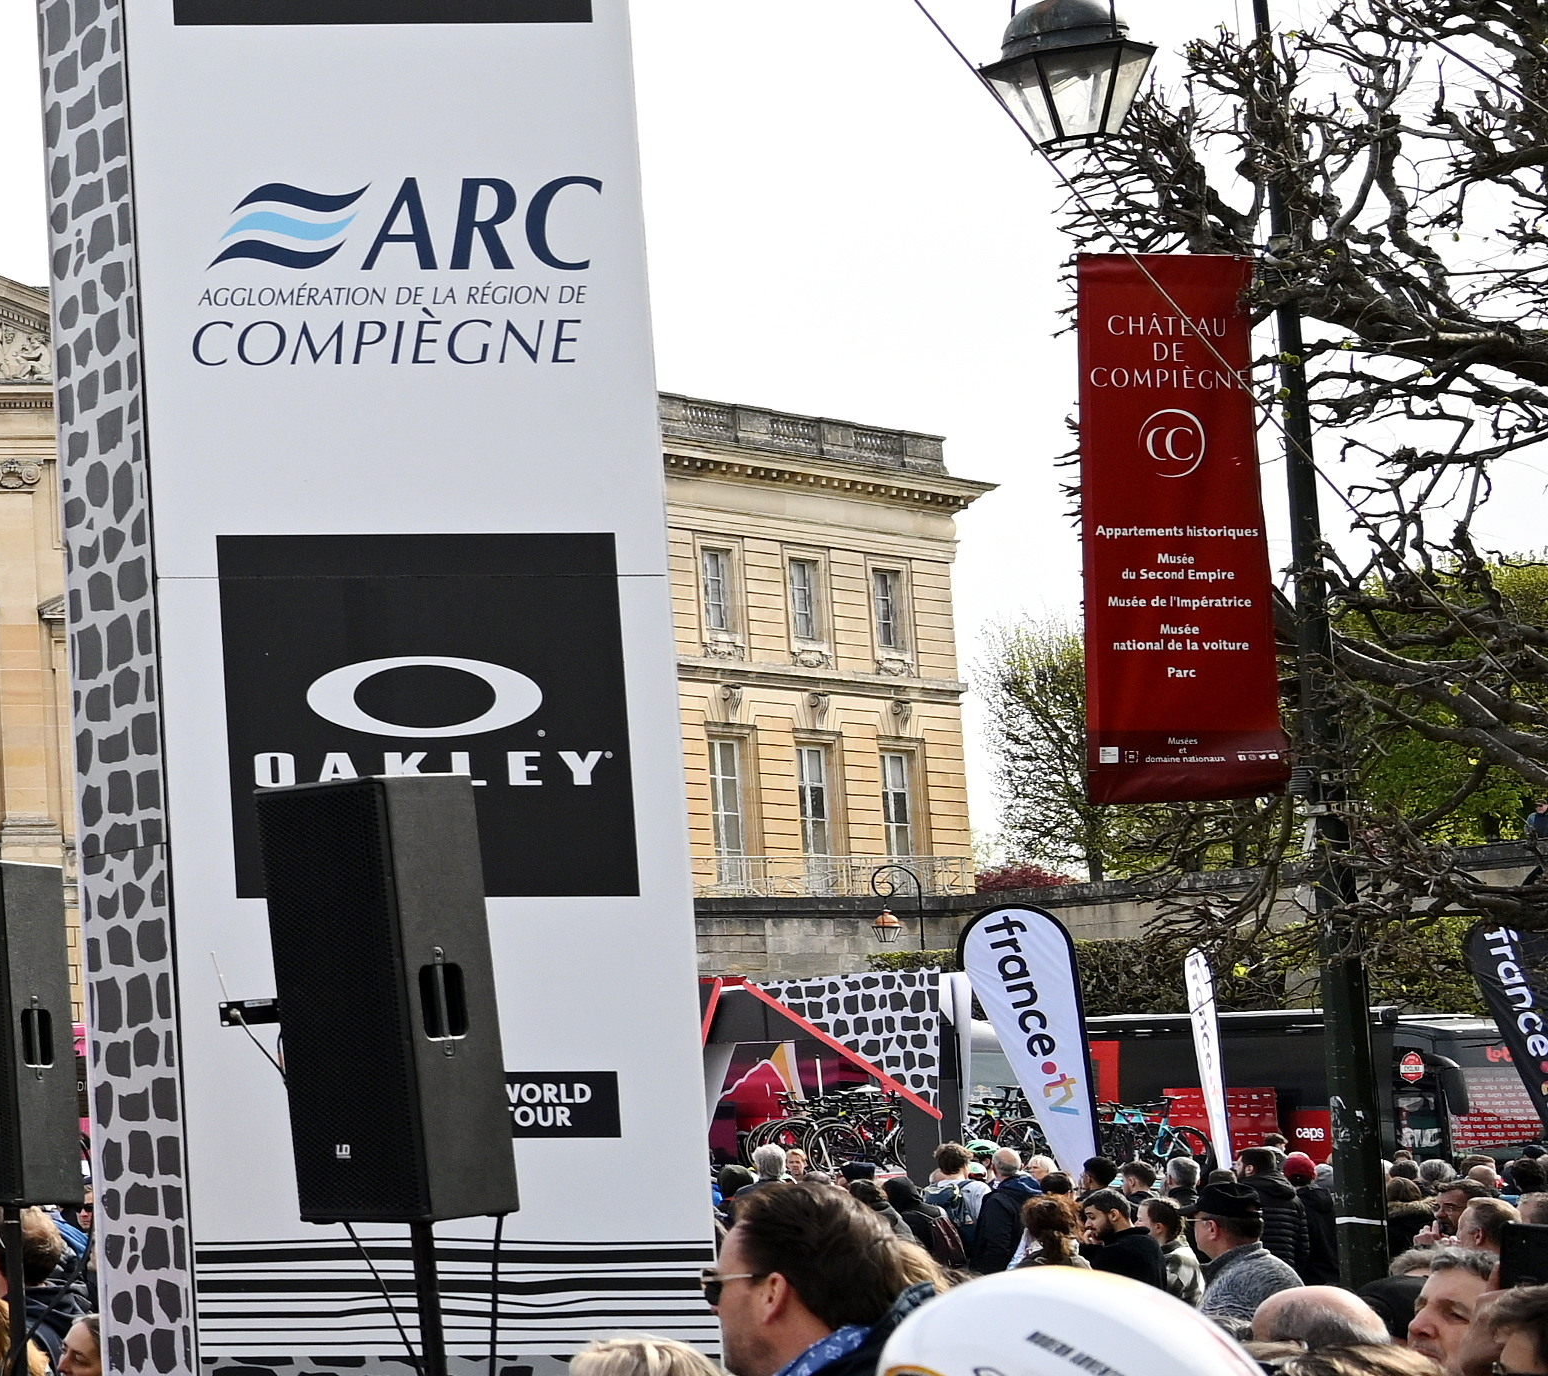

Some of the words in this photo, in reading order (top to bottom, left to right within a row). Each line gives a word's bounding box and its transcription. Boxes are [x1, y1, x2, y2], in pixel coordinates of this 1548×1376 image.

[361, 175, 604, 272] ARC
[197, 280, 387, 307] AGGLOMÉRATION
[395, 285, 424, 305] DE
[431, 285, 457, 305] LA
[465, 278, 550, 306] RÉGION
[559, 284, 587, 305] DE
[1107, 312, 1227, 337] CHÂTEAU
[190, 306, 583, 368] COMPIÈGNE
[1153, 342, 1185, 362] DE
[1090, 365, 1249, 390] COMPIÈGNE
[1095, 525, 1184, 540] Appartements
[1186, 525, 1259, 540] historiques
[1157, 553, 1195, 565] Musée
[1122, 568, 1136, 580] du
[1139, 568, 1185, 580] Second
[1188, 569, 1235, 583] Empire
[1108, 596, 1147, 608] Musée
[1151, 596, 1167, 608] de
[1170, 596, 1252, 610] l'Impératrice
[1160, 623, 1200, 635] Musée
[1113, 638, 1164, 651] national
[1167, 638, 1183, 651] de
[1186, 638, 1199, 651] la
[1203, 638, 1249, 651] voiture
[1167, 667, 1196, 678] Parc
[1167, 737, 1198, 745] Musées
[1145, 754, 1181, 763] domaine
[1182, 754, 1226, 763] nationaux
